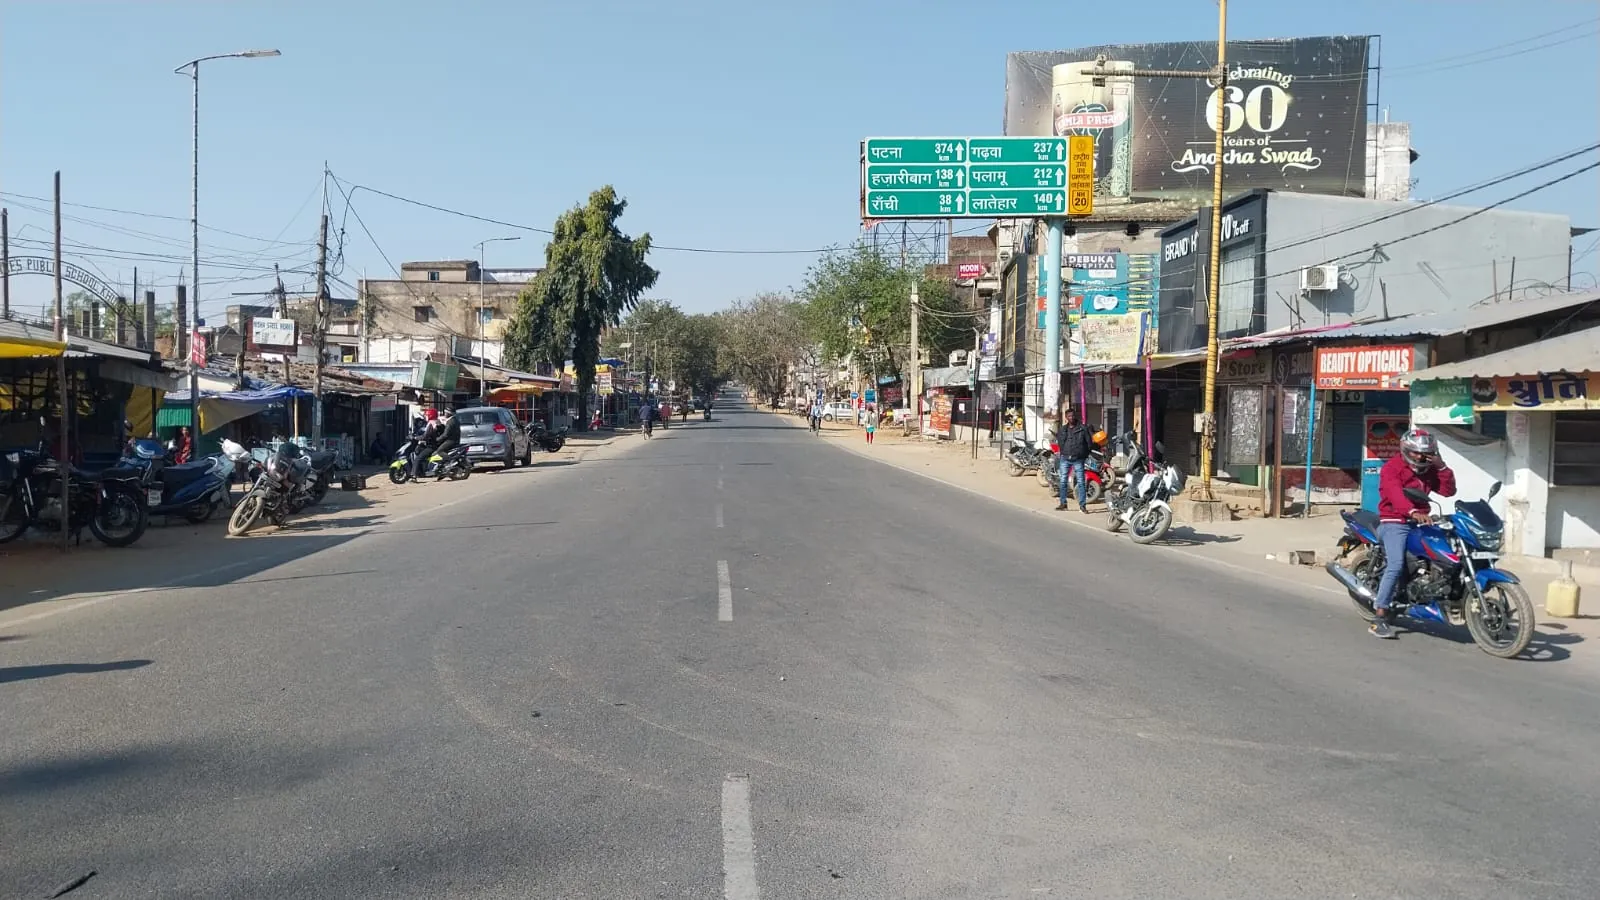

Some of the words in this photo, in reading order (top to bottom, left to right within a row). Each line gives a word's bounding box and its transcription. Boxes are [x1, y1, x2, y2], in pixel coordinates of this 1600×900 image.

[1206, 84, 1288, 133] 60
[871, 147, 903, 158] पटना
[934, 142, 954, 154] 374
[970, 146, 1002, 160] गढ़वा
[1033, 142, 1053, 153] 237
[1260, 147, 1316, 165] Swad
[871, 168, 932, 187] हज़ारीबाग
[935, 168, 954, 180] 138
[972, 171, 1008, 186] पलामू
[1033, 168, 1053, 179] 212
[871, 195, 899, 211] राँची
[939, 194, 952, 206] 38
[972, 194, 1018, 210] लातेहार
[1033, 193, 1054, 204] 140
[1074, 198, 1087, 206] 20
[1165, 238, 1189, 262] BRAND
[27, 258, 55, 272] PUBLI
[1068, 256, 1114, 264] DEBUKA
[1320, 352, 1356, 373] BEAUTY
[1358, 349, 1409, 372] OPTICALS
